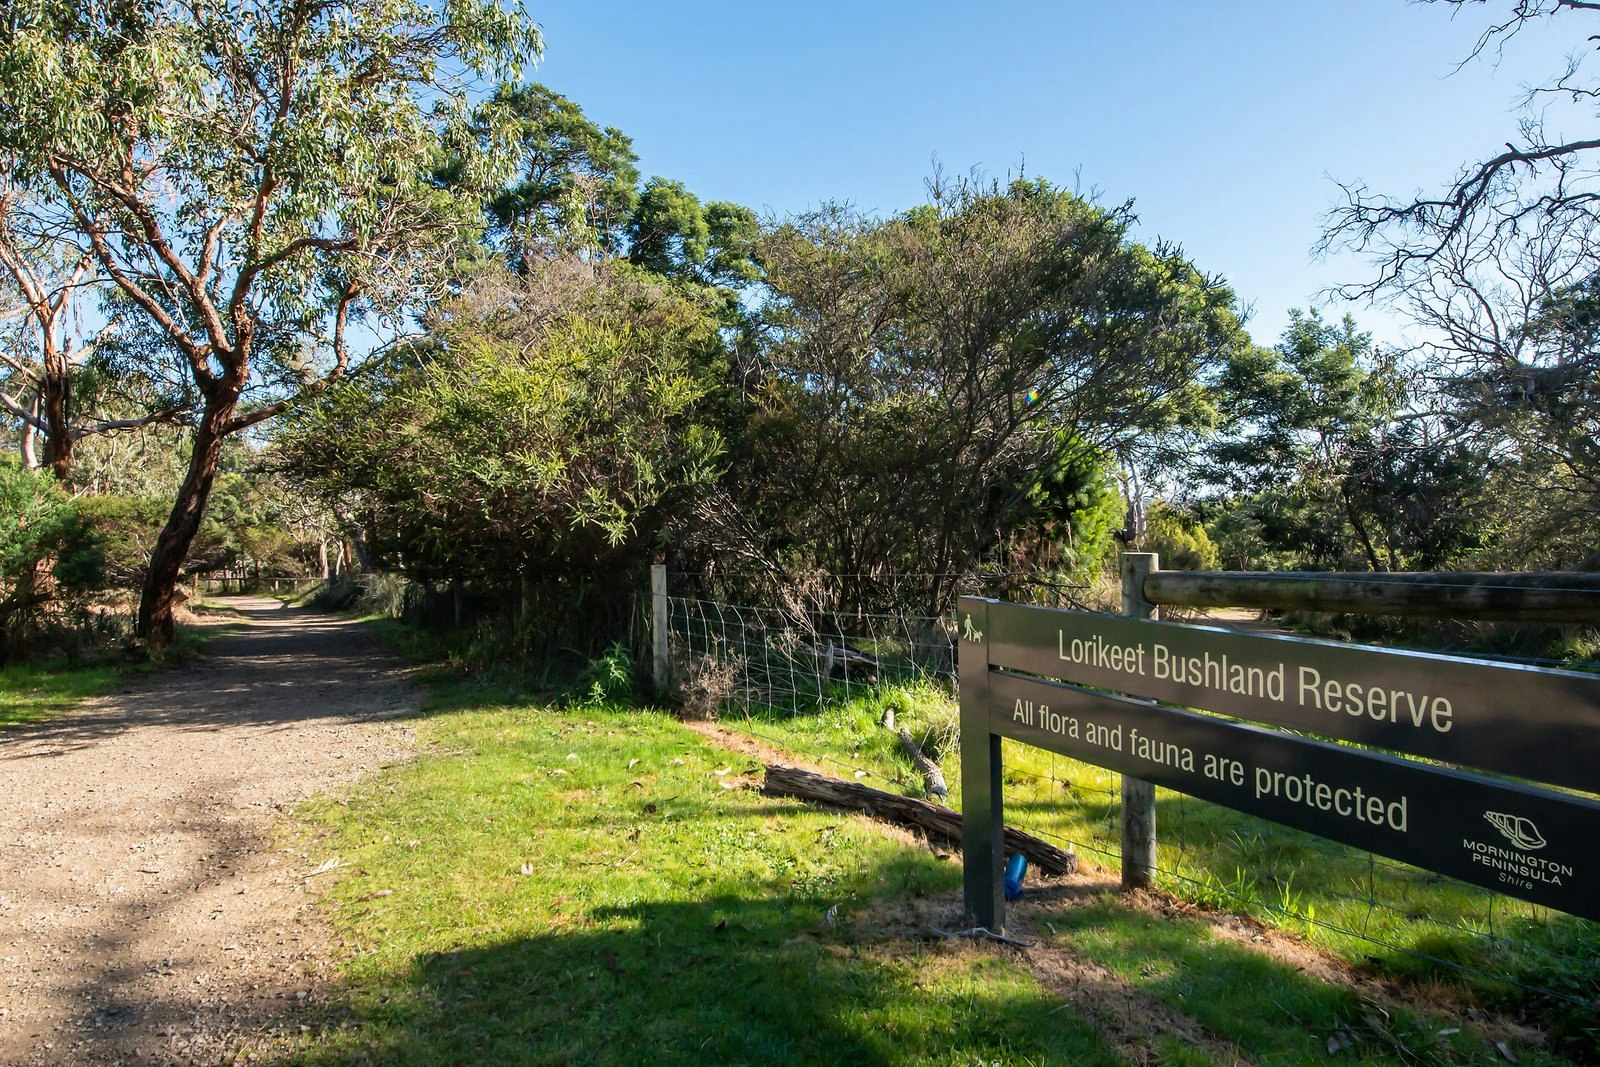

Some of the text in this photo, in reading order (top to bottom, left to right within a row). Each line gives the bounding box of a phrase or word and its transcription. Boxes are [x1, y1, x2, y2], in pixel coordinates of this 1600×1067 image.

[1058, 629, 1453, 733] Lorikeet Bushland Reserve
[1013, 698, 1407, 832] All flora and fauna are protected
[1463, 839, 1573, 877] MORNINGTON
[1472, 852, 1562, 887] PENINSULA
[1498, 872, 1533, 890] Shire
